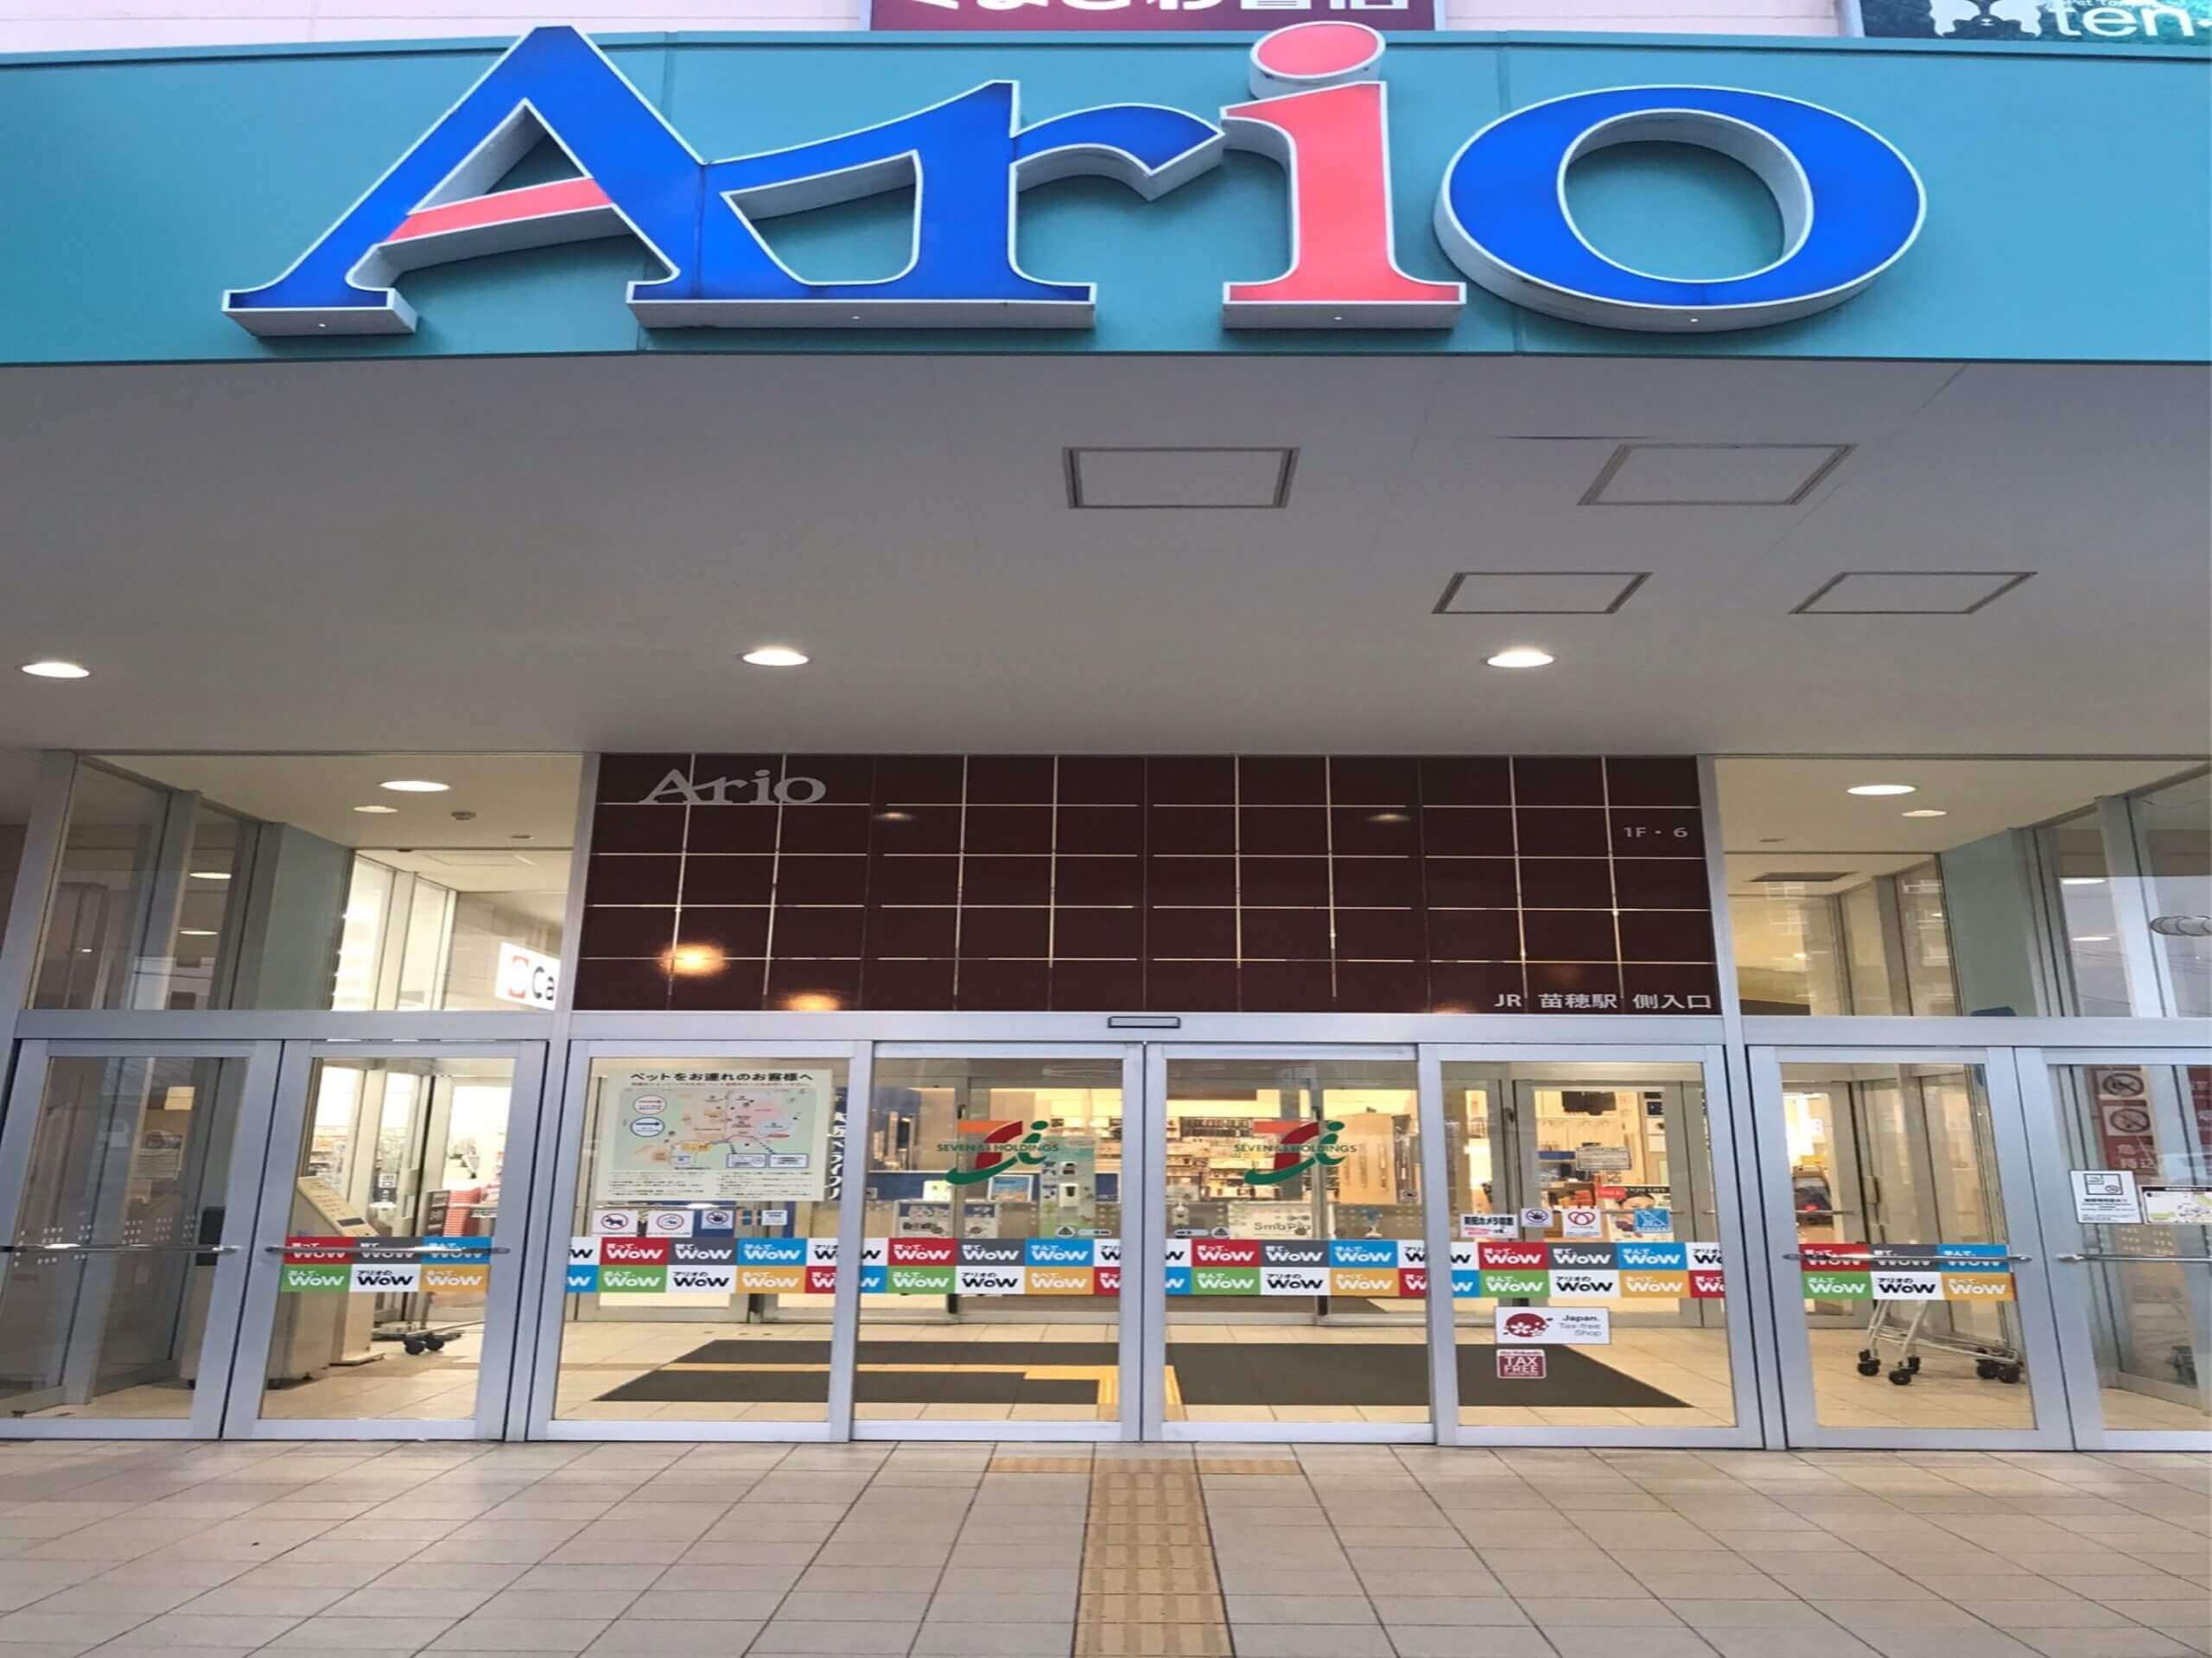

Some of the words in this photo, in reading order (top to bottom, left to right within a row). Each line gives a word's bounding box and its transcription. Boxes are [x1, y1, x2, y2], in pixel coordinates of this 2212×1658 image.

[221, 21, 1927, 321] Ario
[639, 768, 827, 804] Ario
[1494, 994, 1522, 1007] JR
[1538, 994, 1618, 1008] 苗穂駅
[1632, 994, 1713, 1008] 側入口
[1504, 1356, 1538, 1365] TAX
